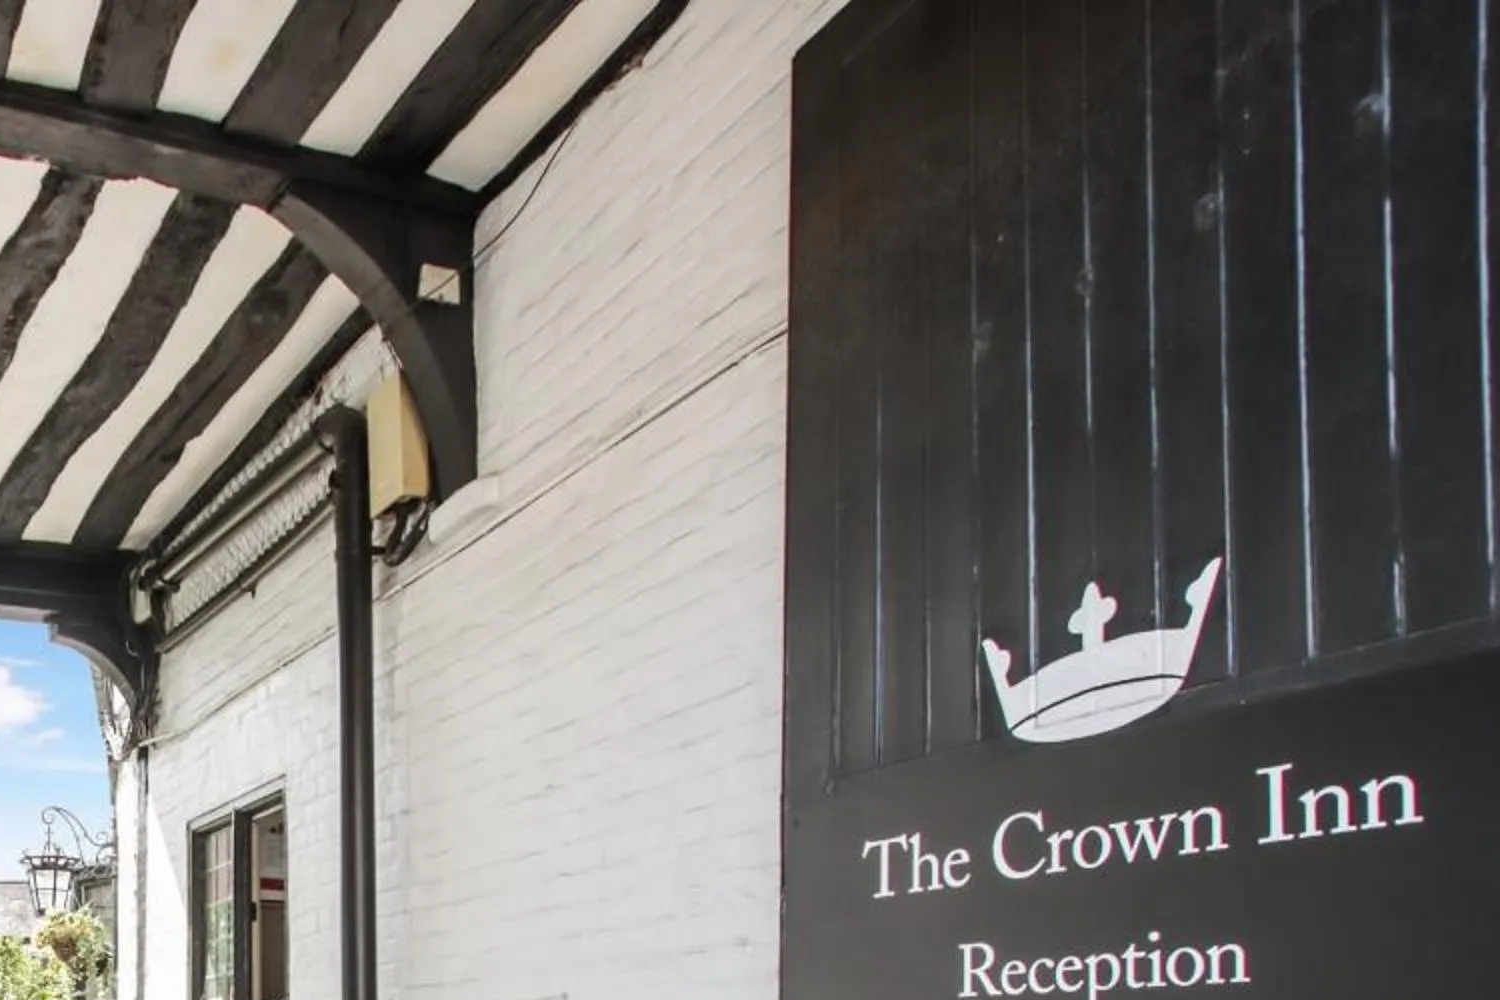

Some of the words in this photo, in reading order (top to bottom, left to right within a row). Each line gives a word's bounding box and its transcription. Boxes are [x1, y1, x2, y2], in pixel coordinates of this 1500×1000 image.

[861, 831, 972, 900] The
[991, 803, 1229, 880] Crown
[1255, 762, 1425, 845] Inn
